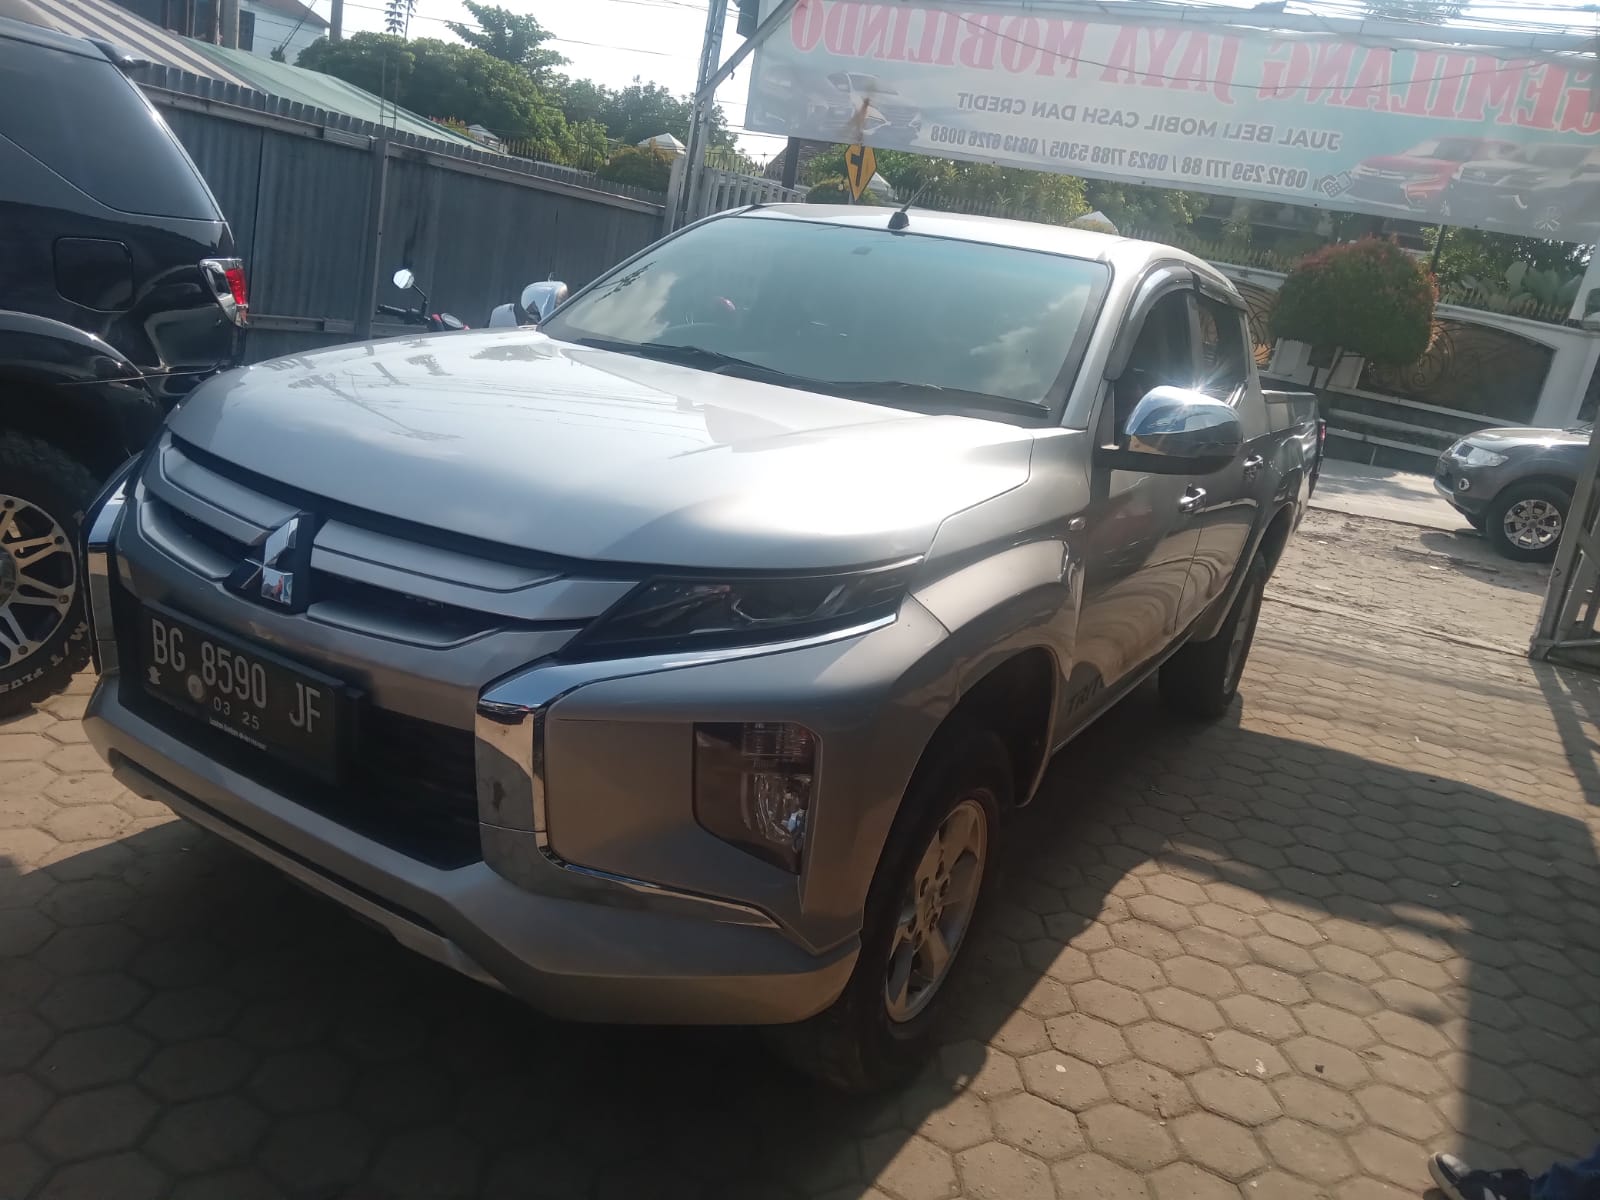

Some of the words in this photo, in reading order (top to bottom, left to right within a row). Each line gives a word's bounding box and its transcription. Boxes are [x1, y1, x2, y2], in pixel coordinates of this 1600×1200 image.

[151, 618, 186, 672] BG
[201, 641, 267, 709] 8590
[289, 682, 321, 733] JF
[213, 696, 231, 716] 03
[242, 711, 260, 730] 25
